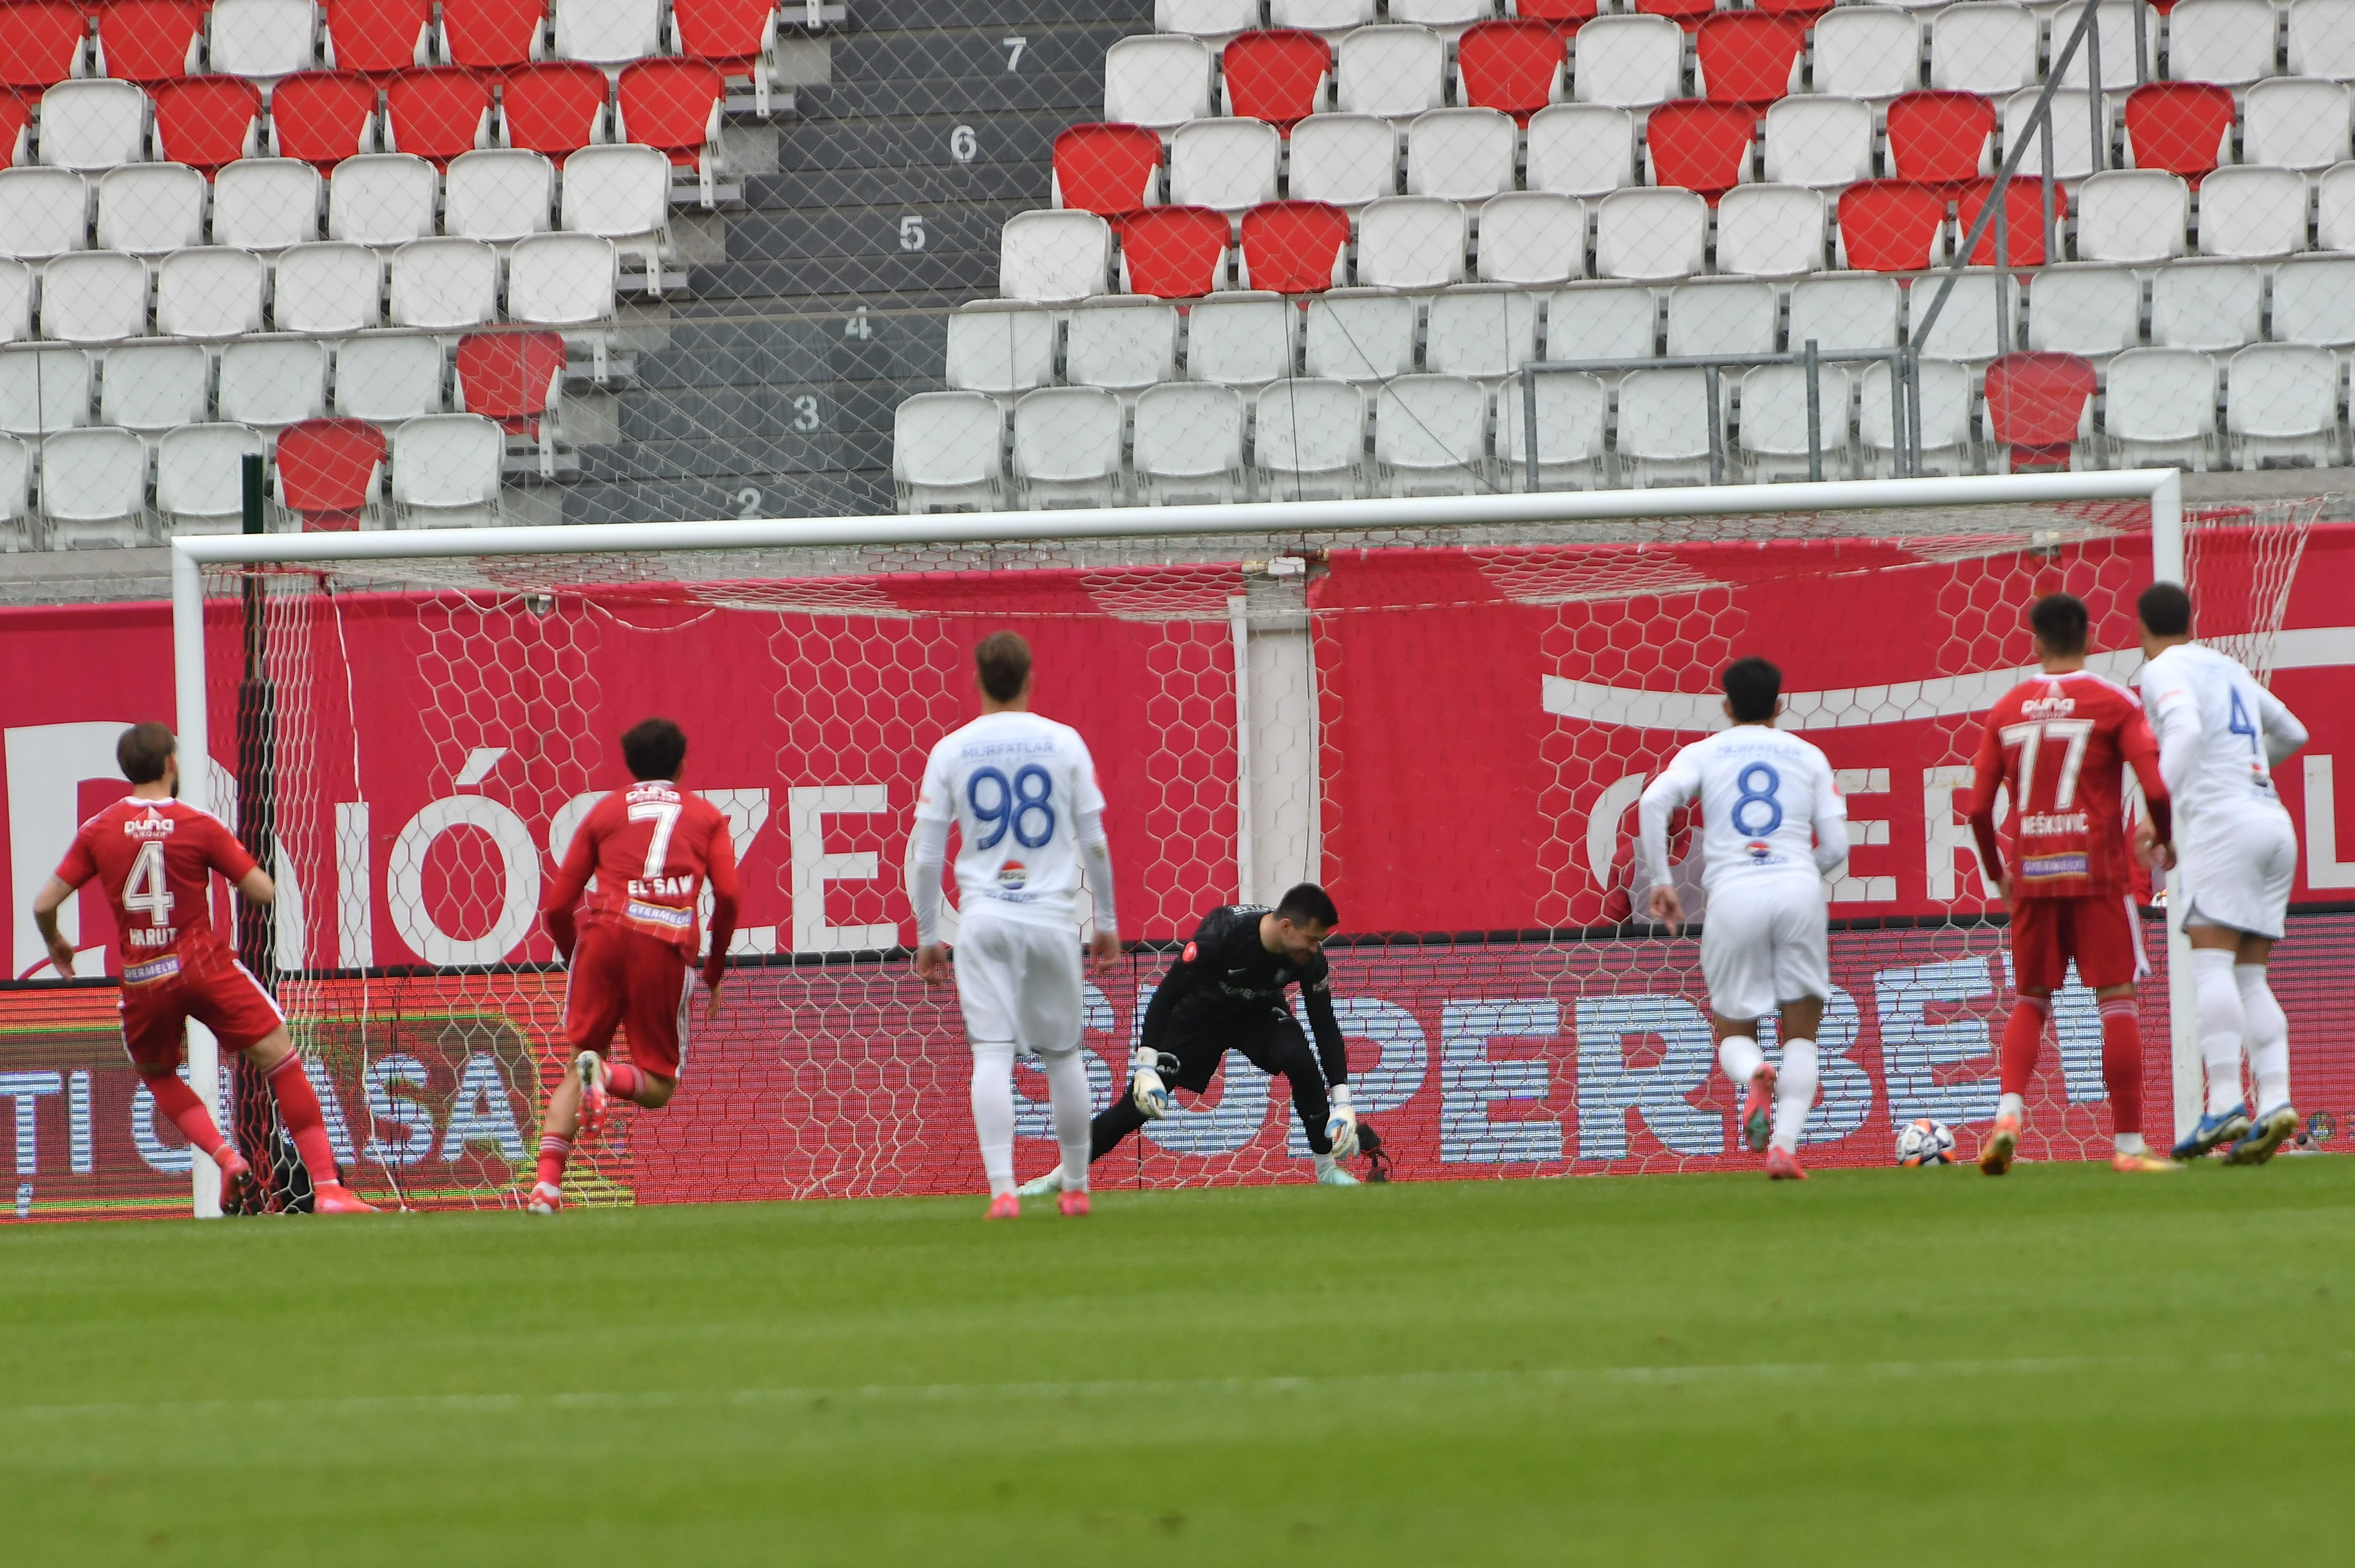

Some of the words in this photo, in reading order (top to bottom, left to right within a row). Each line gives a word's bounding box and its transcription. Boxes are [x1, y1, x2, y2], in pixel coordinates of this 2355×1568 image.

[1003, 37, 1027, 73] 7
[951, 125, 977, 162] 6
[900, 216, 926, 251] 5
[845, 306, 872, 340] 4
[794, 395, 820, 430] 3
[737, 487, 762, 520] 2
[2229, 685, 2257, 755] 4
[1999, 718, 2095, 812] 77
[967, 764, 1055, 850] 98
[1731, 761, 1783, 837] 8
[627, 801, 683, 878] 7
[122, 841, 175, 926] 4
[129, 927, 178, 947] HARUT
